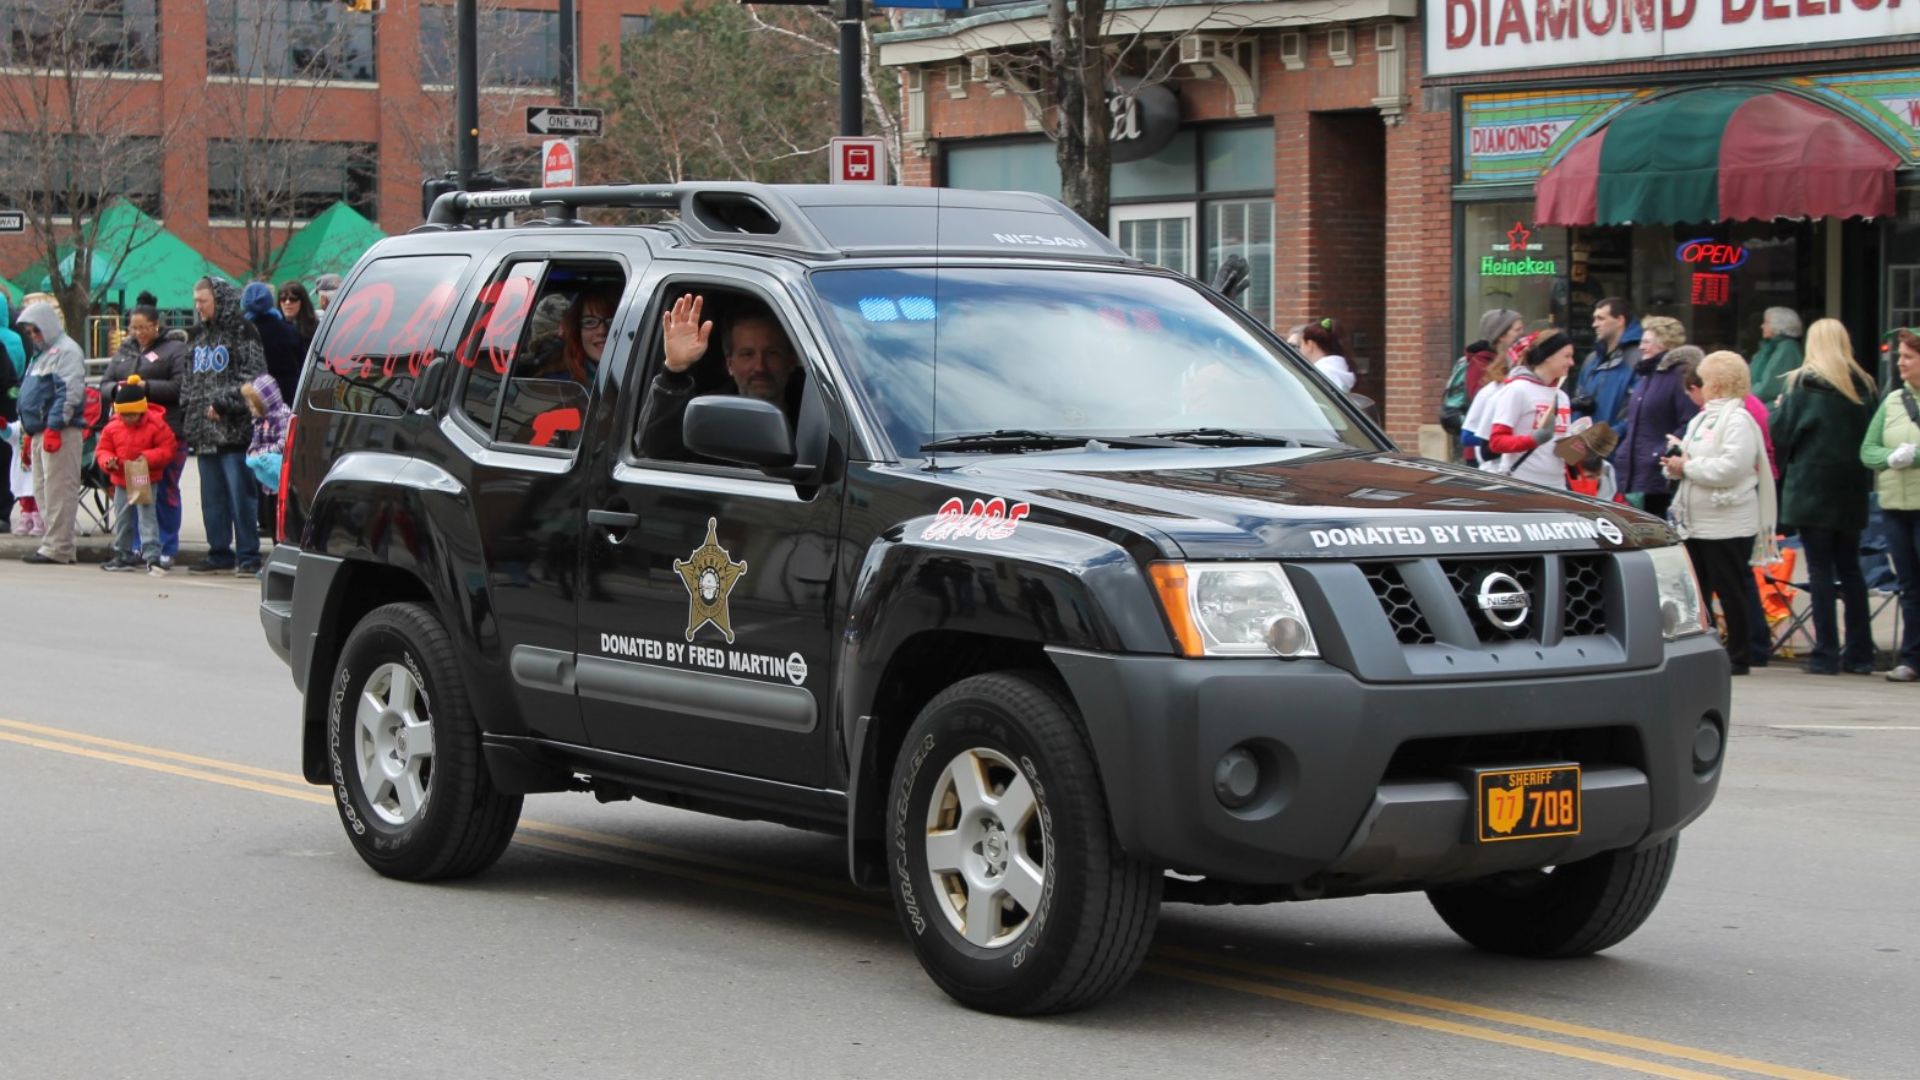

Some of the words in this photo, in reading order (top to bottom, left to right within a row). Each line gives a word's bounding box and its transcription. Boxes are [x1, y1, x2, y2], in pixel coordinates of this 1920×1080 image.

[1446, 0, 1697, 49] DIAMOND
[548, 115, 570, 127] ONE
[573, 117, 595, 129] WAY
[992, 233, 1088, 248] NISSAN
[1683, 244, 1742, 264] OPEN
[1481, 256, 1556, 275] Heineken
[1310, 527, 1426, 548] DONATED
[1430, 525, 1462, 544] BY
[1469, 523, 1522, 544] FRED
[1527, 521, 1599, 541] MARTIN
[1487, 594, 1530, 606] NISSAN
[601, 633, 663, 660] DONATED
[666, 643, 686, 663] BY
[689, 646, 726, 669] FRED
[729, 651, 786, 678] MARTIN
[1508, 771, 1553, 787] SHERIFF
[1495, 795, 1516, 821] 77
[1528, 789, 1574, 829] 708
